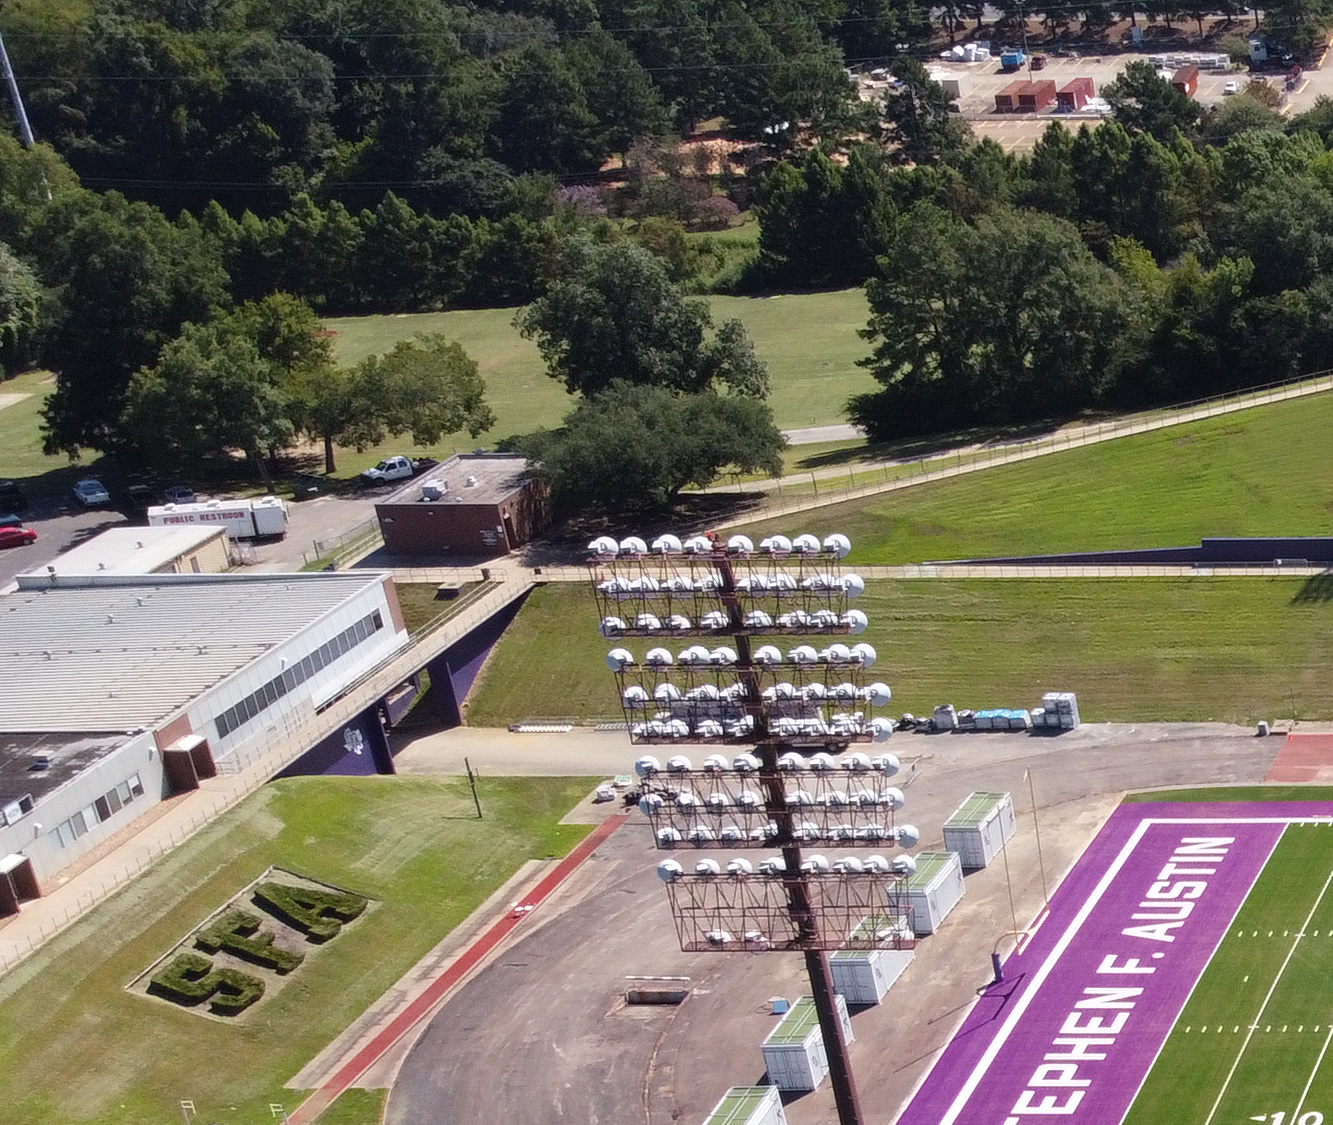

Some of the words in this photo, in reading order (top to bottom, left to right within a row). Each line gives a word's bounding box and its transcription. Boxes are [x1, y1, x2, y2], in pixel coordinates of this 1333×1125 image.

[163, 515, 195, 524] PUBLIC
[1122, 836, 1236, 943] AUSTIN
[146, 881, 369, 1016] SFA
[1097, 951, 1165, 974] F.
